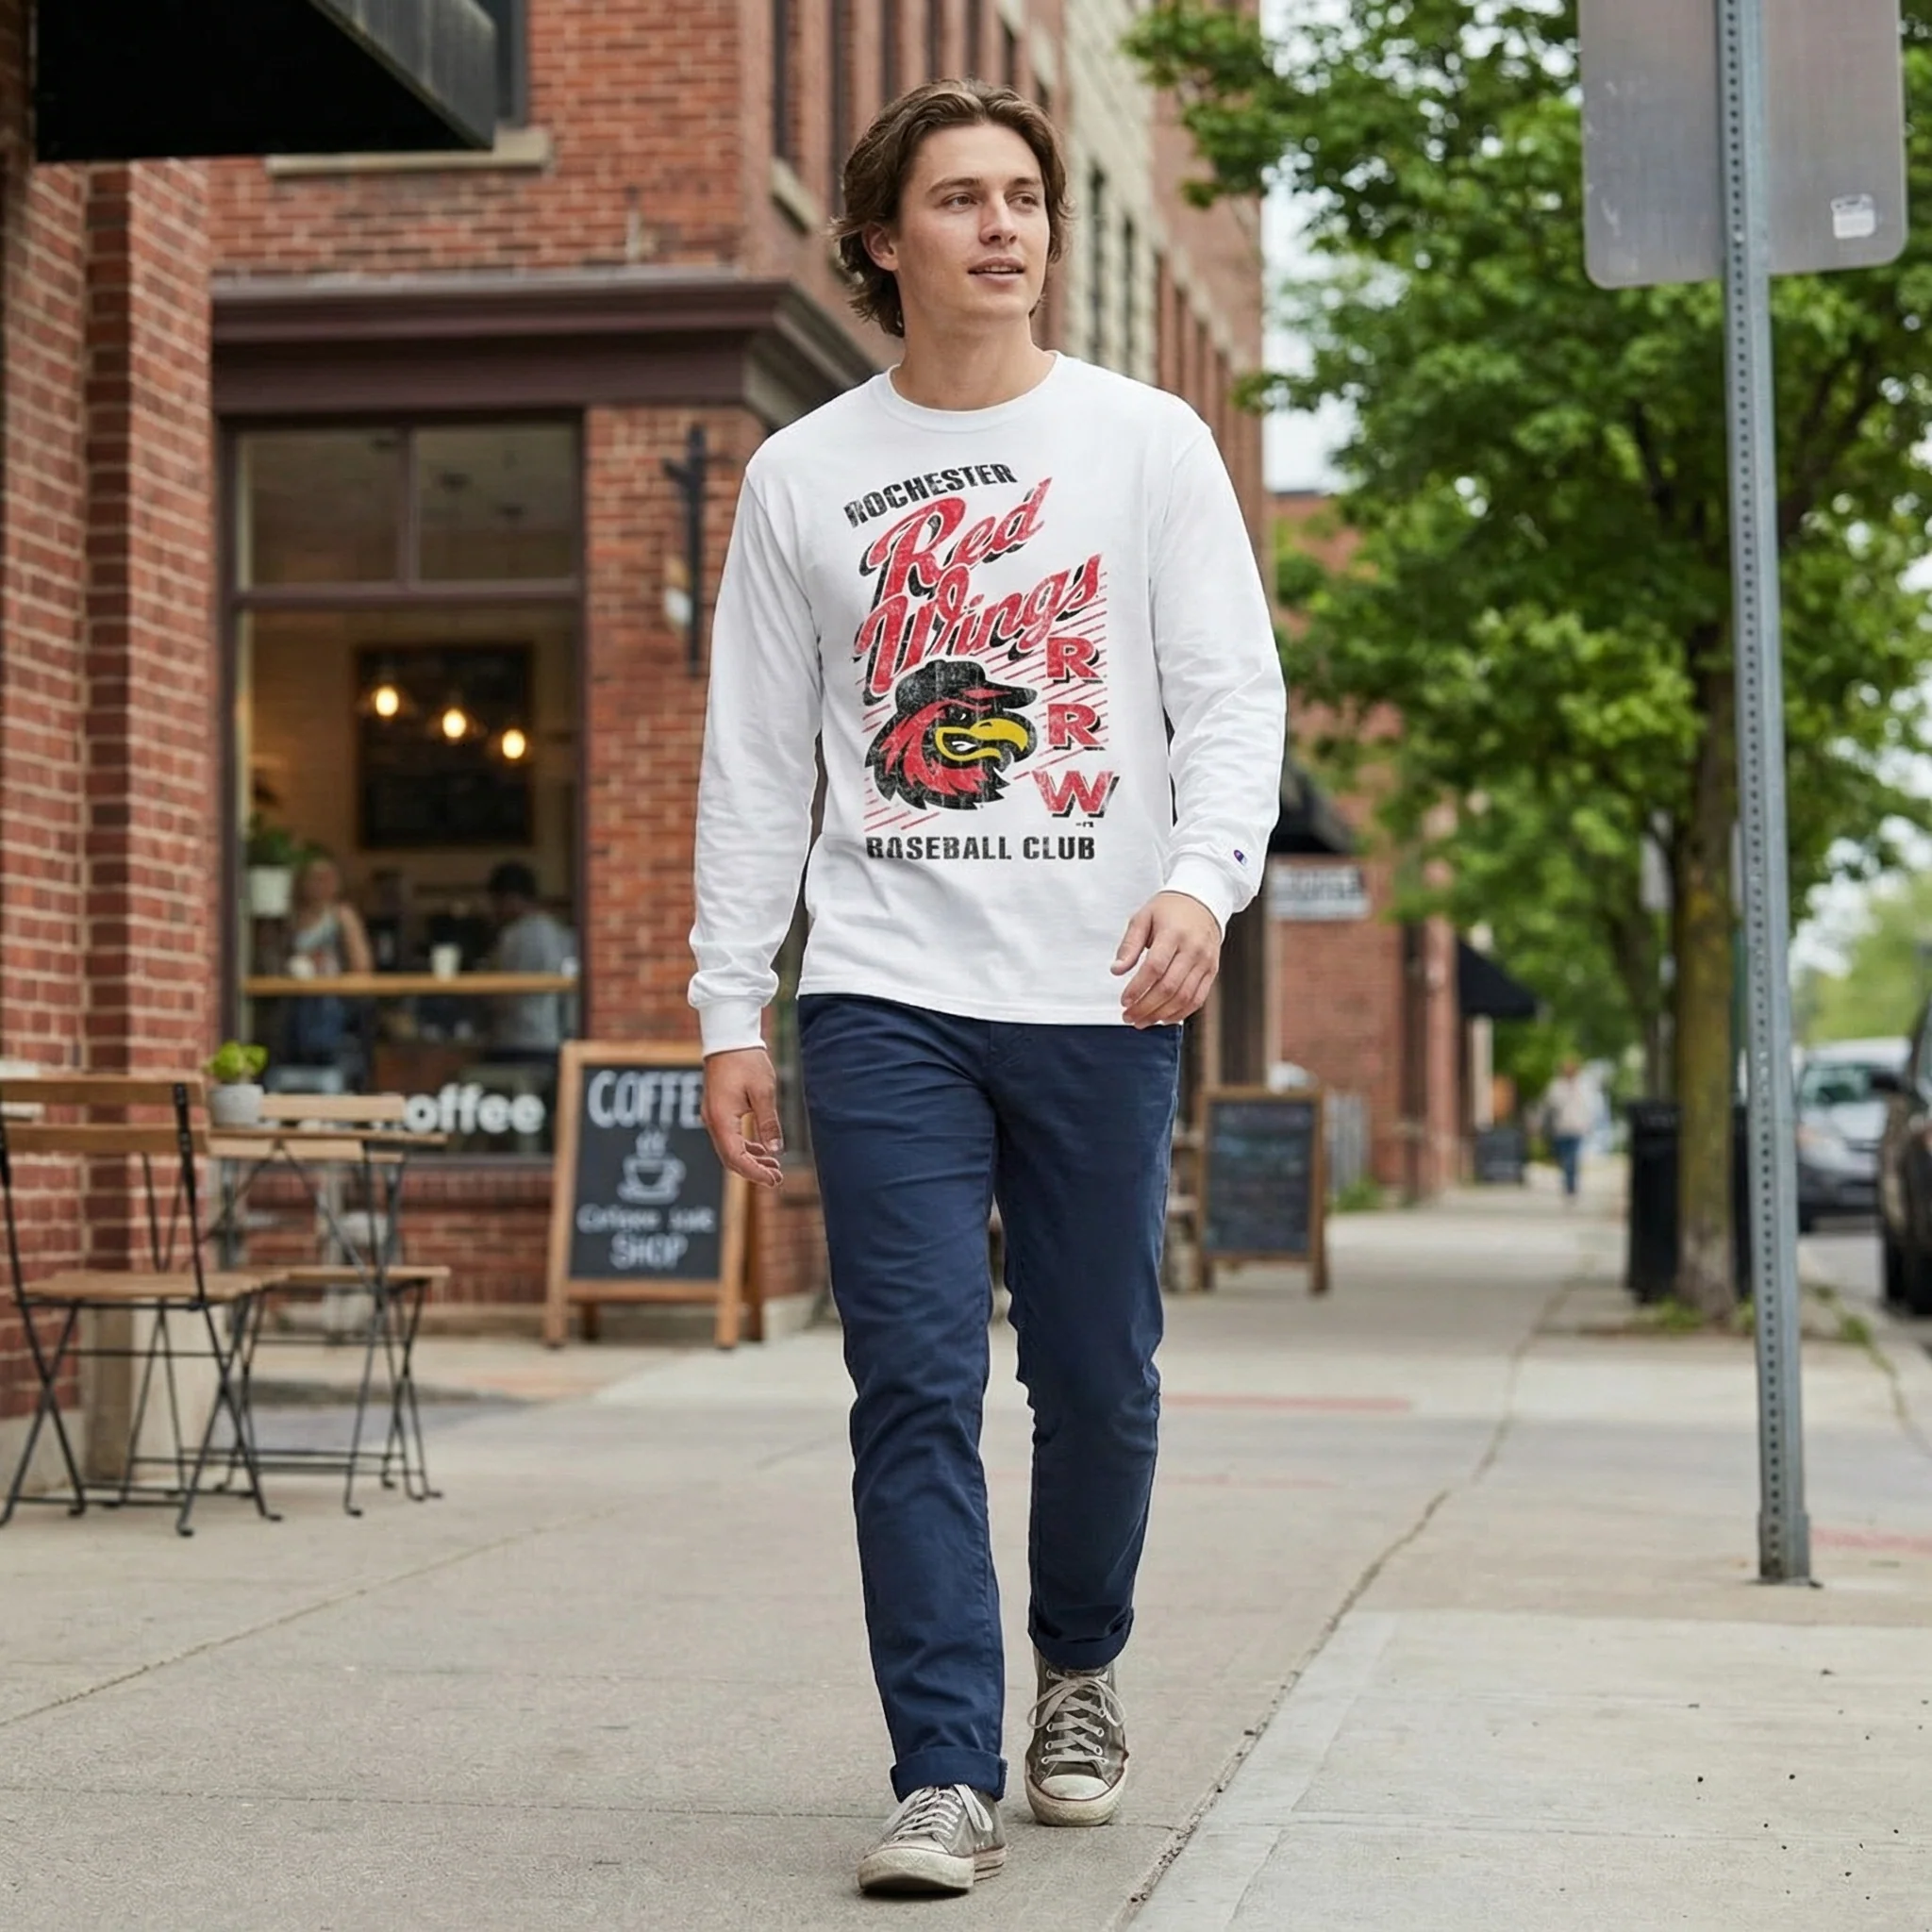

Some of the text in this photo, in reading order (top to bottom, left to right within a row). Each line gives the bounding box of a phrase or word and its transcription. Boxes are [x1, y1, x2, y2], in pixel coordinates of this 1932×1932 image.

[844, 463, 1018, 528] ROCHESTER
[858, 476, 1053, 613] Red
[853, 554, 1103, 707] Wings
[865, 836, 1095, 859] BASEBALL CLUB
[404, 1081, 545, 1134] offee
[587, 1069, 708, 1129] COFFE
